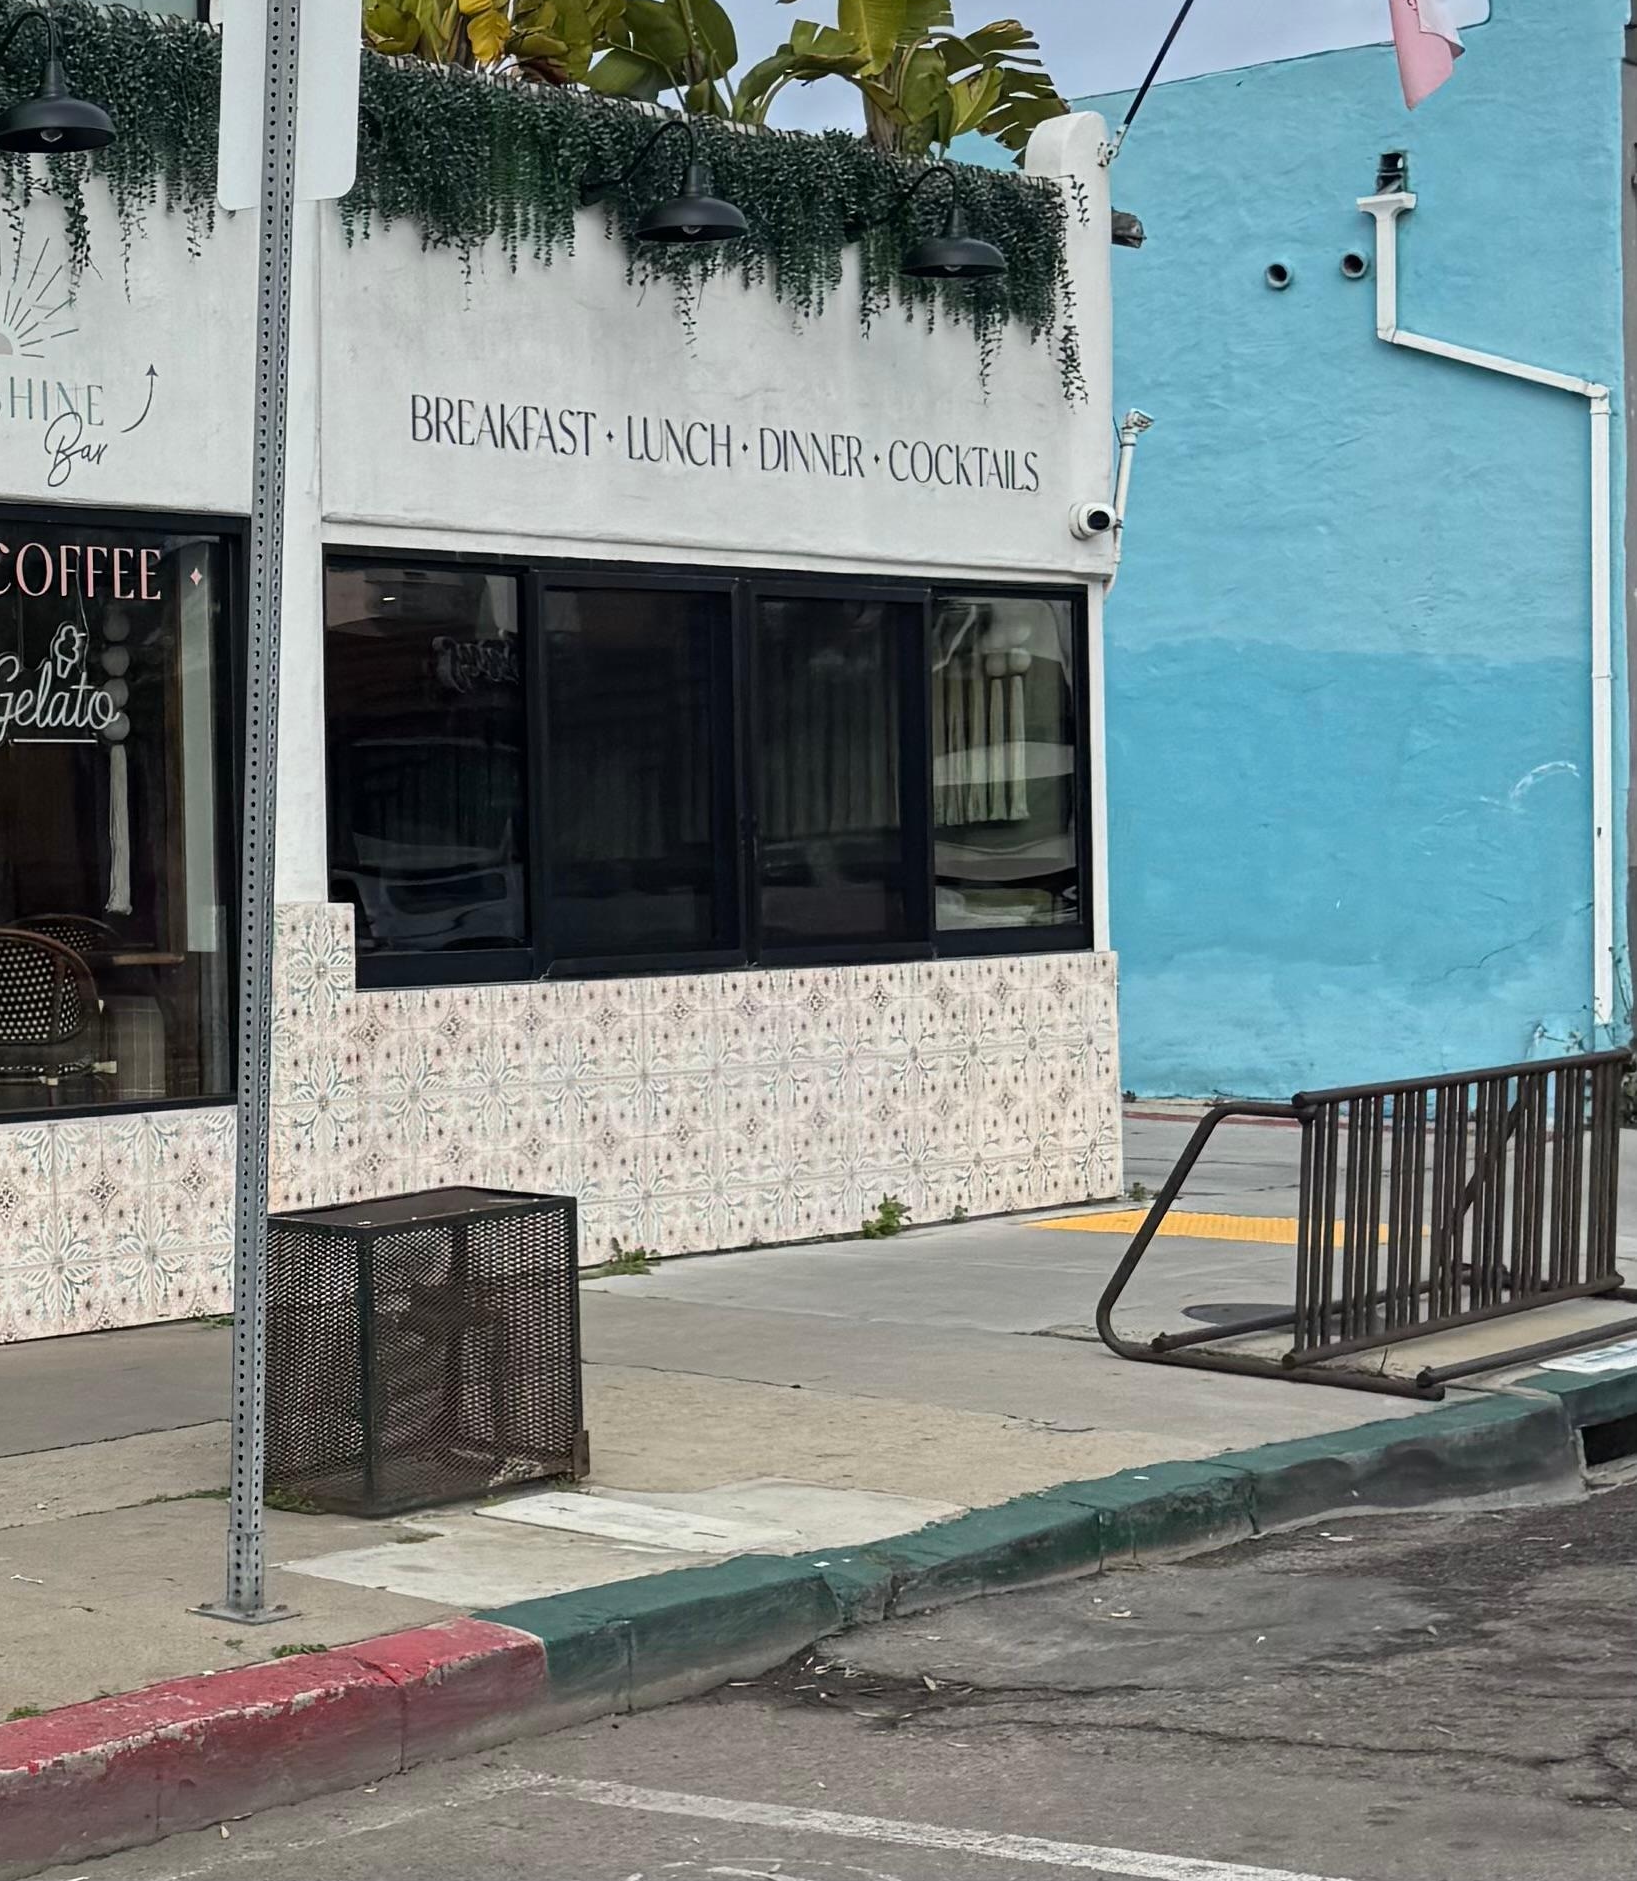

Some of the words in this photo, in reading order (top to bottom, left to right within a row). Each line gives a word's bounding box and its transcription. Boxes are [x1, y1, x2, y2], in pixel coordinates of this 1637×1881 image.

[44, 411, 109, 488] Bar
[410, 393, 598, 457] BREAKFAST
[626, 415, 732, 468] LUNCH
[758, 427, 866, 479] DINNER
[888, 440, 1041, 493] COCKTAILS
